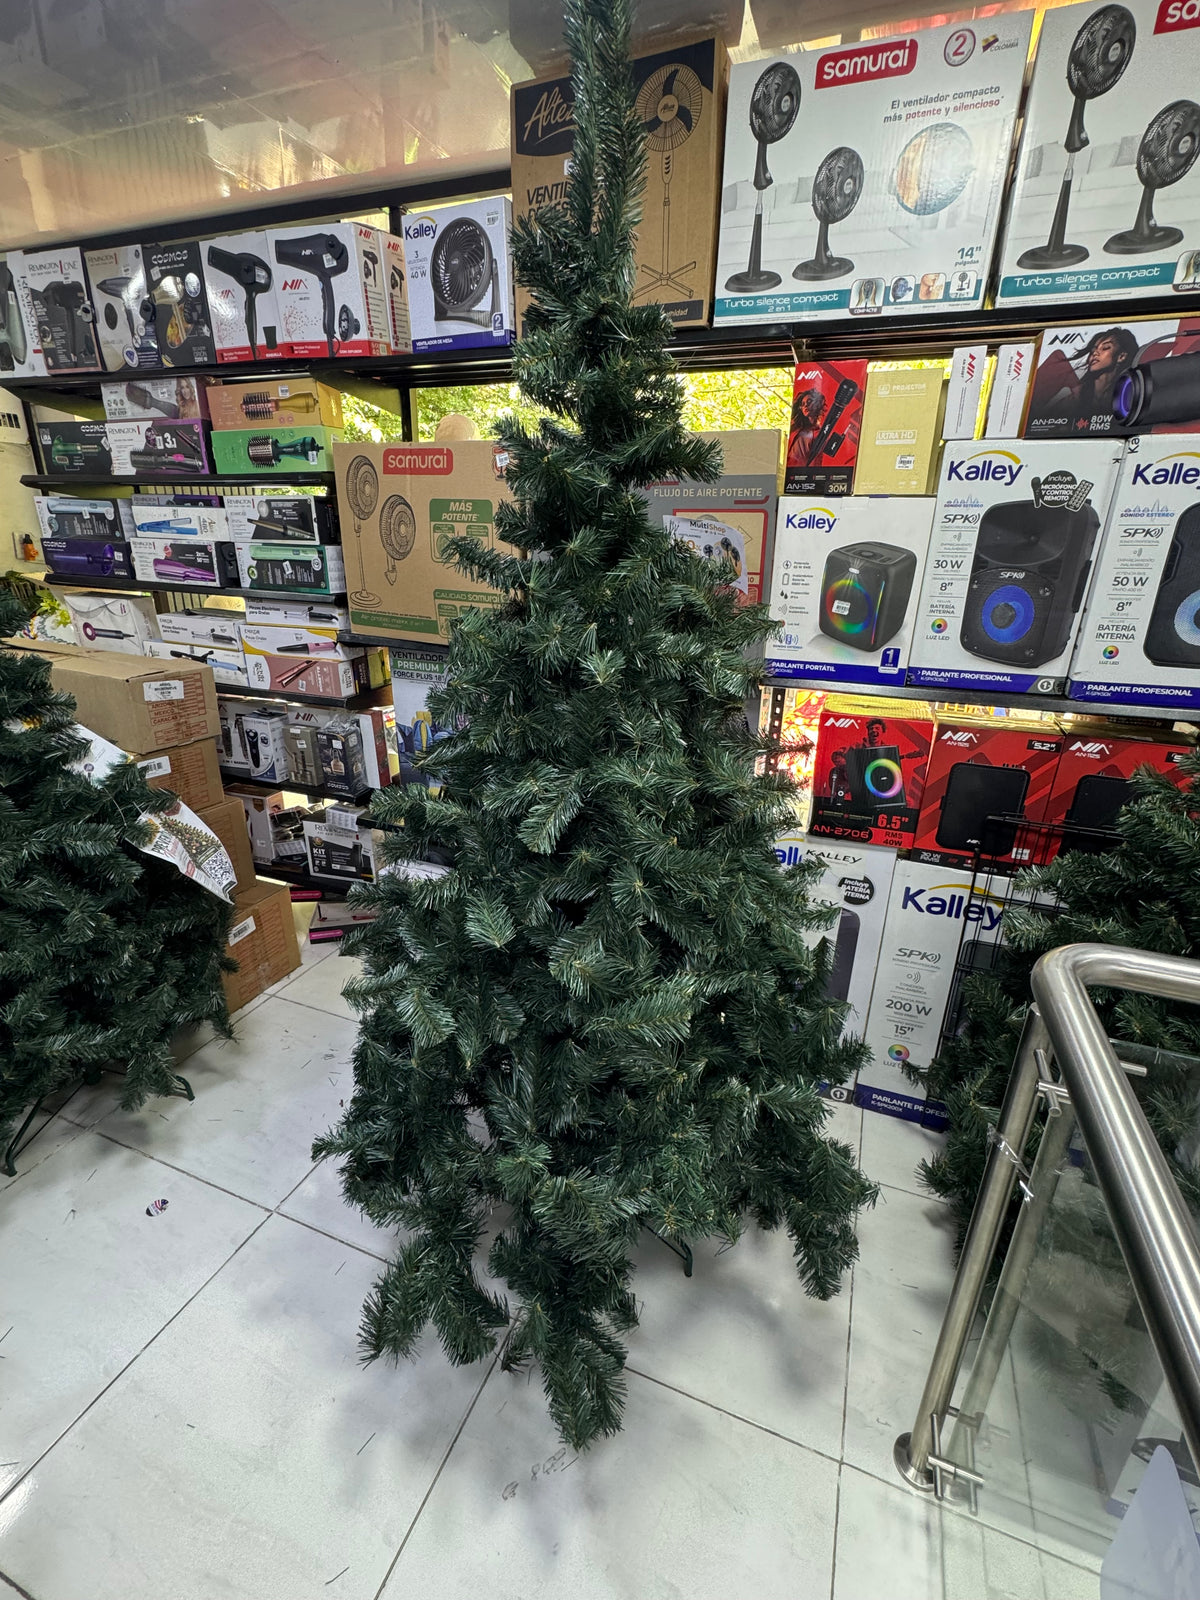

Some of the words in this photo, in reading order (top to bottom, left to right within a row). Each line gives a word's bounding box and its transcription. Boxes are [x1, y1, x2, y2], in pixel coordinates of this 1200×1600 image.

[952, 33, 967, 57] 2
[822, 39, 911, 81] samurai
[890, 99, 901, 110] El
[902, 92, 950, 109] ventilador
[952, 85, 1001, 103] compacto
[883, 112, 903, 123] más
[904, 106, 942, 122] potente
[944, 107, 951, 117] y
[953, 97, 1001, 114] silencioso
[405, 223, 438, 241] Kalley
[151, 249, 188, 264] COSMOS
[954, 259, 980, 268] pulgadas
[411, 271, 419, 279] 40
[419, 270, 427, 278] W
[1014, 276, 1052, 288] Turbo
[1055, 273, 1097, 286] silence
[1102, 268, 1160, 283] compact
[282, 279, 309, 291] NIA
[723, 297, 753, 310] Turbo
[756, 295, 790, 308] silence
[792, 293, 839, 307] compact
[495, 315, 502, 327] 2
[1048, 332, 1087, 346] NIA
[965, 353, 976, 383] NIA
[1011, 350, 1024, 381] NIA
[797, 370, 823, 381] NIA
[892, 383, 927, 391] PROJECTOR
[1031, 417, 1069, 426] AN-P40
[1091, 414, 1114, 423] 80W
[109, 427, 137, 436] REMINGTON
[1089, 421, 1111, 431] RMS
[878, 432, 898, 440] ULTRA
[901, 431, 914, 439] HD
[388, 448, 448, 470] samurai
[947, 460, 1025, 487] Kalley
[1047, 475, 1073, 483] Incluye
[1132, 462, 1200, 490] Kalle
[653, 488, 682, 497] FLUJO
[682, 488, 695, 497] DE
[696, 488, 718, 497] AIRE
[720, 487, 763, 497] POTENTE
[828, 484, 848, 493] 30M
[1041, 482, 1077, 491] MICRÓFONO
[449, 500, 473, 512] MÁS
[442, 512, 478, 522] POTENTE
[689, 520, 727, 534] MultiShop
[786, 514, 837, 533] Kalley
[934, 560, 949, 569] 30
[950, 560, 964, 569] W
[1112, 576, 1130, 587] 50
[1133, 576, 1149, 587] W
[435, 592, 467, 600] CALIDAD
[930, 602, 956, 610] BATERÍA
[1097, 623, 1137, 632] BATERÍA
[1095, 632, 1135, 641] INTERNA
[391, 651, 444, 663] VENTILADOR
[886, 649, 895, 664] 1
[397, 660, 439, 672] PREMIUM
[805, 663, 836, 672] PORTÁTIL
[393, 669, 415, 678] FORCE
[415, 671, 433, 680] PLUS
[921, 670, 959, 679] PARLANTE
[959, 672, 1013, 682] PROFESIONAL
[1086, 684, 1132, 693] PARLANTE
[1132, 686, 1193, 697] PROFESIONAL
[153, 715, 178, 724] CARACAS
[295, 712, 319, 723] NIA
[824, 717, 860, 729] NIA
[941, 730, 978, 744] NIA
[1069, 741, 1110, 755] NIA
[813, 824, 869, 839] AN-2706
[884, 831, 904, 839] RMS
[883, 838, 903, 846] 40W
[806, 849, 863, 864] KALLEY
[844, 878, 870, 888] Incluye
[844, 891, 870, 900] NTERNA
[902, 886, 1004, 931] Kalley
[885, 998, 912, 1012] 200
[915, 1004, 933, 1016] W
[872, 1093, 914, 1109] PARLANTE
